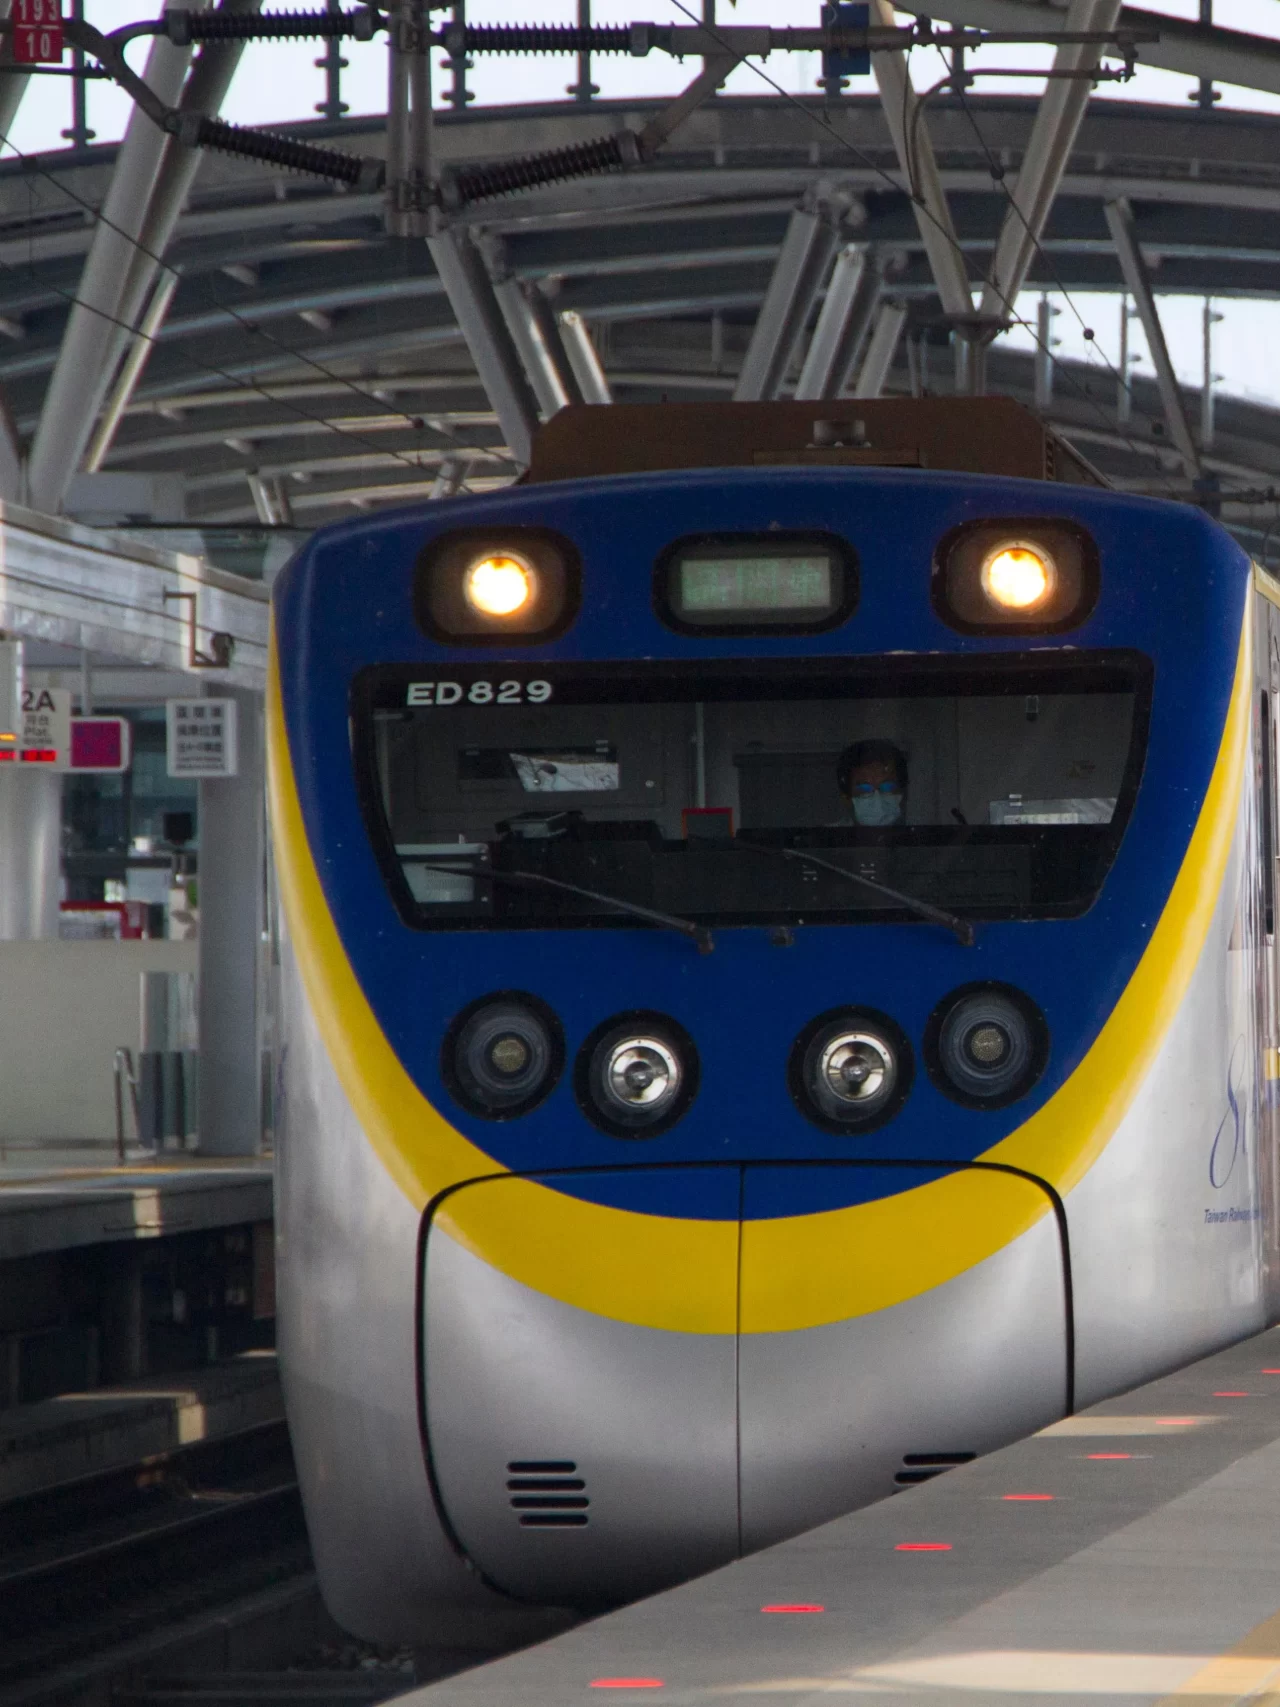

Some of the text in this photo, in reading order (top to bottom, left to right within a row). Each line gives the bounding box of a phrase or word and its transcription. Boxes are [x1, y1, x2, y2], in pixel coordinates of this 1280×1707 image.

[27, 32, 51, 58] 10
[22, 690, 55, 712] 2A
[407, 680, 552, 706] ED829
